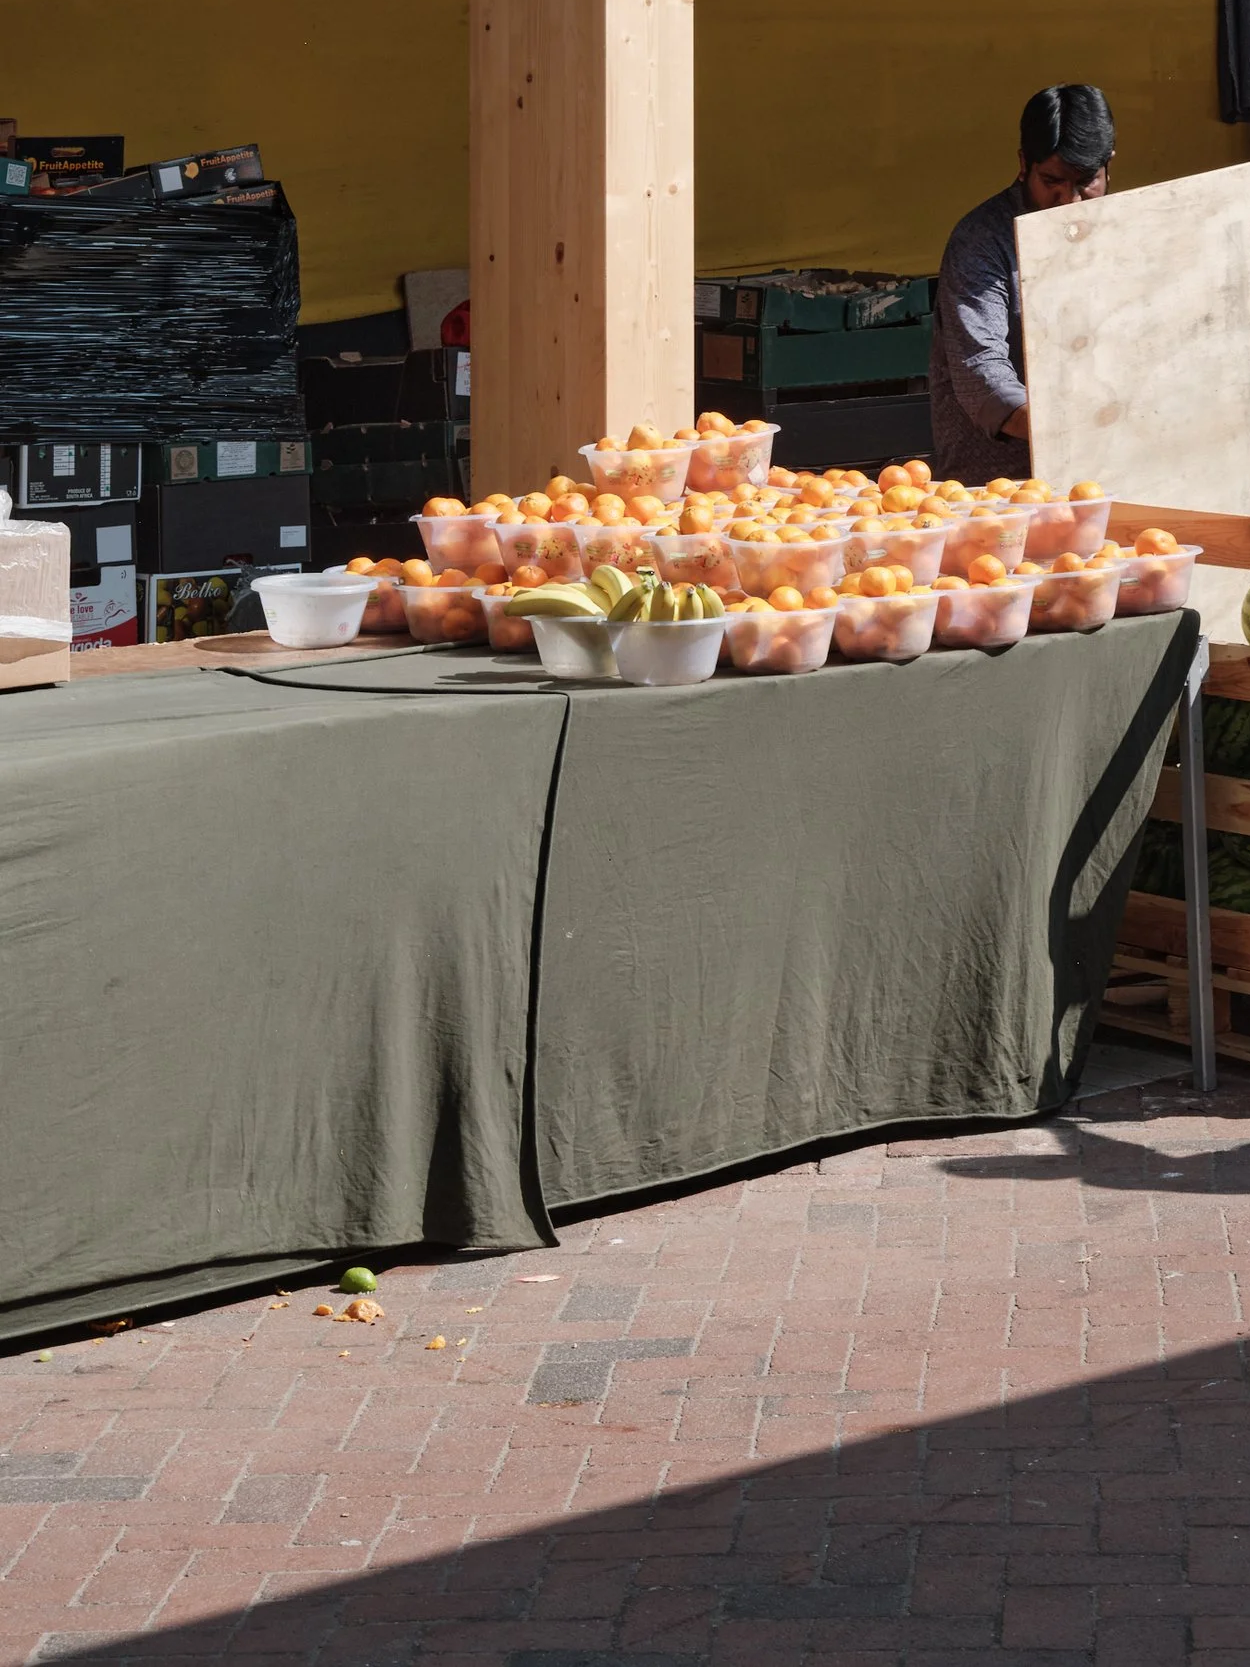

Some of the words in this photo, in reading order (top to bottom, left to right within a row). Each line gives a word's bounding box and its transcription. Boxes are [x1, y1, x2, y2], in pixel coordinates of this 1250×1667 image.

[200, 150, 254, 167] FruitAppetite
[39, 160, 104, 172] FruitAppetite
[77, 604, 94, 614] love
